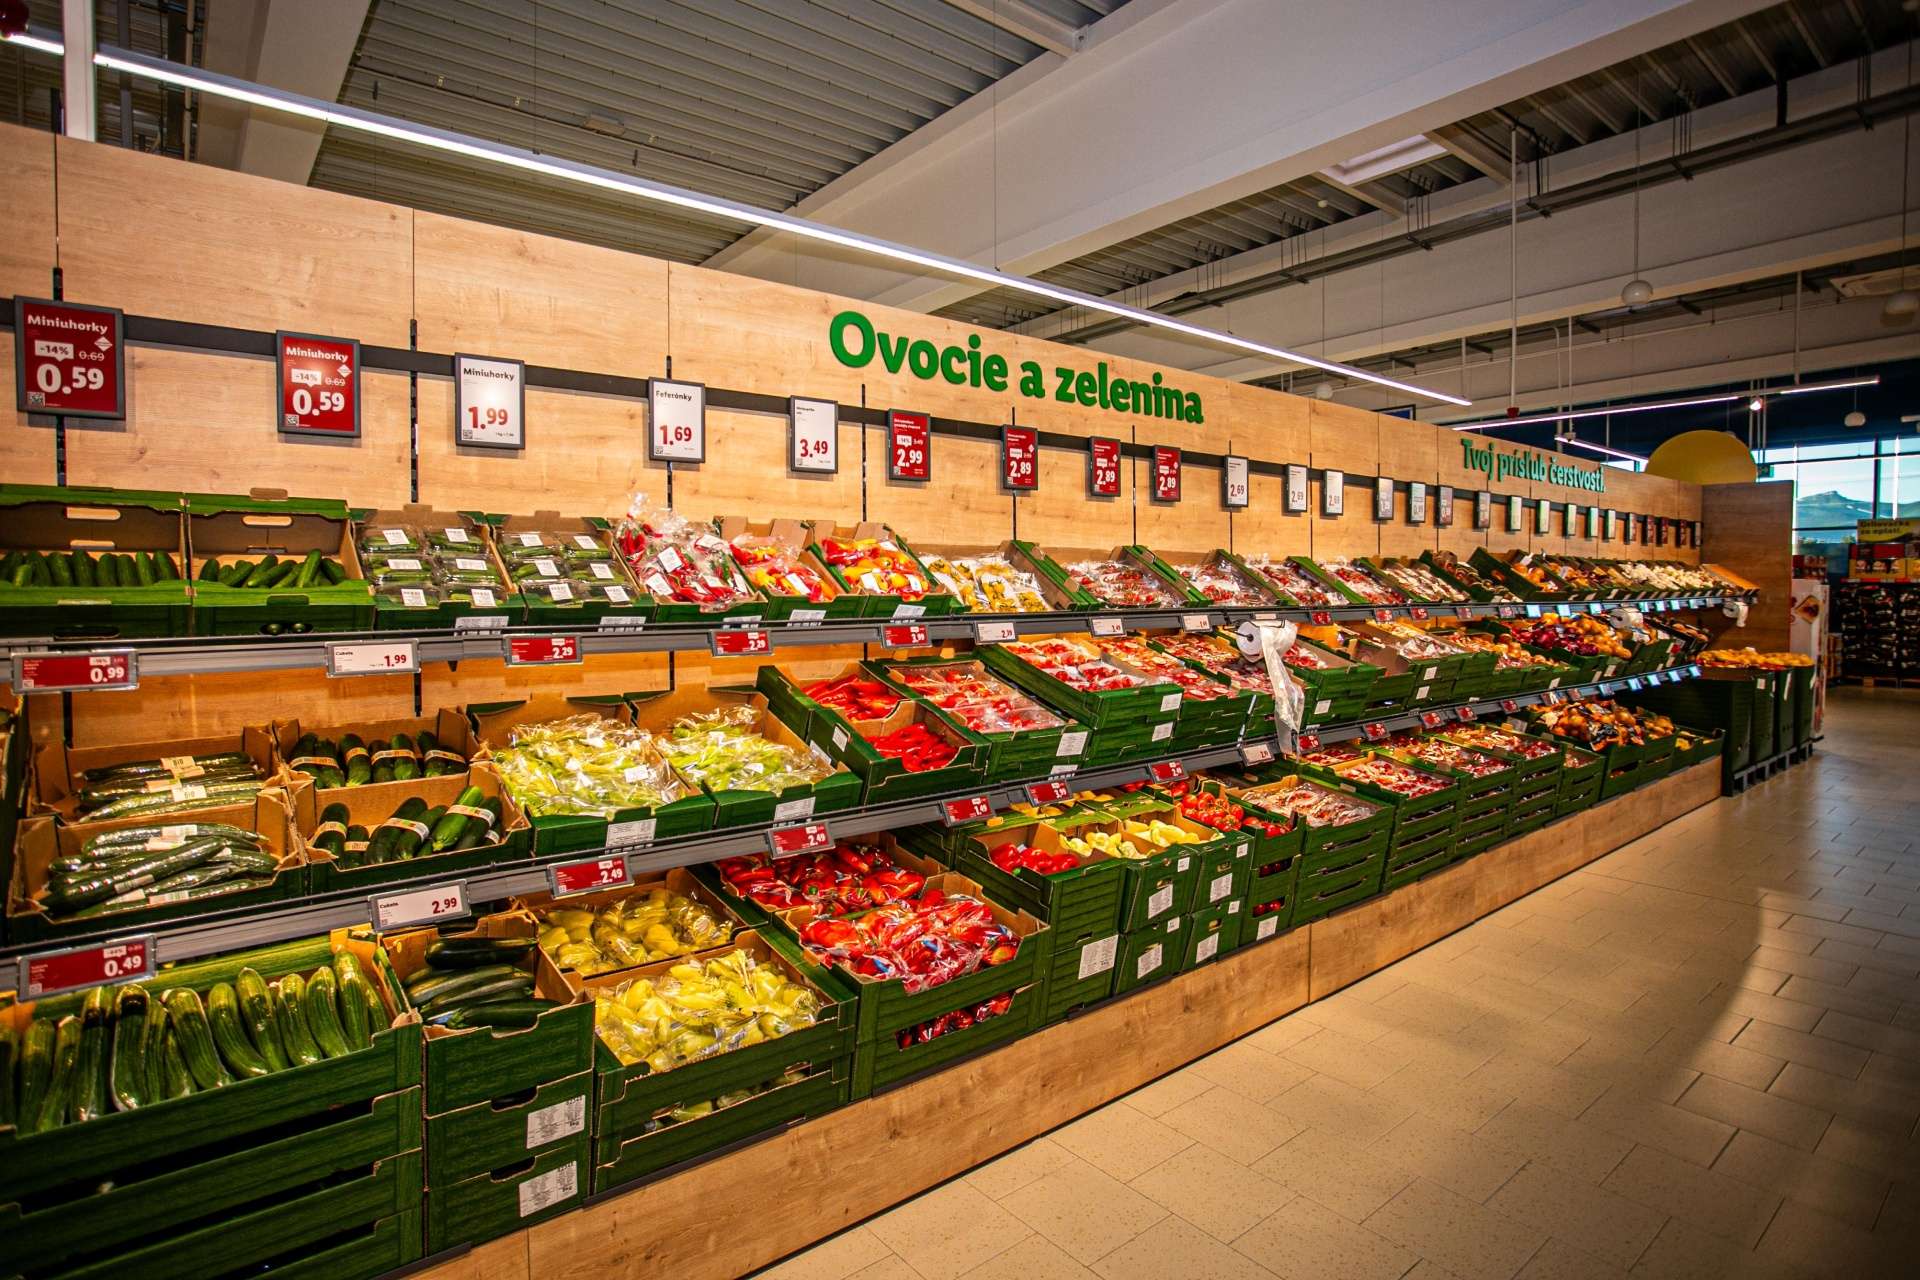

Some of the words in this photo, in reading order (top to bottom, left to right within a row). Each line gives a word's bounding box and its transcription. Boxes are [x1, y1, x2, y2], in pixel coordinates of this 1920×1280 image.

[27, 314, 108, 335] Miniuhorky
[40, 345, 68, 355] -14%
[286, 346, 348, 363] Miniuhorky
[463, 367, 515, 381] Miniuhorky
[829, 311, 1009, 392] Ovocie
[1020, 361, 1045, 399] a
[1055, 362, 1205, 425] zelenina
[37, 363, 104, 394] 0.59
[295, 373, 317, 381] -14%
[292, 389, 345, 416] 0.59
[468, 406, 508, 429] 1.99
[660, 424, 692, 445] 1.69
[800, 438, 828, 457] 3.49
[897, 449, 922, 467] 2.99
[1461, 438, 1494, 480] Tvoj
[1010, 461, 1031, 477] 2.89
[1096, 470, 1115, 485] 2.89
[1160, 476, 1176, 491] 2.89
[384, 654, 407, 667] 1.99
[552, 647, 573, 658] 2.29
[90, 667, 124, 682] 0.99
[600, 868, 623, 883] 2.49
[432, 897, 457, 914] 2.99
[104, 955, 142, 977] 0.49
